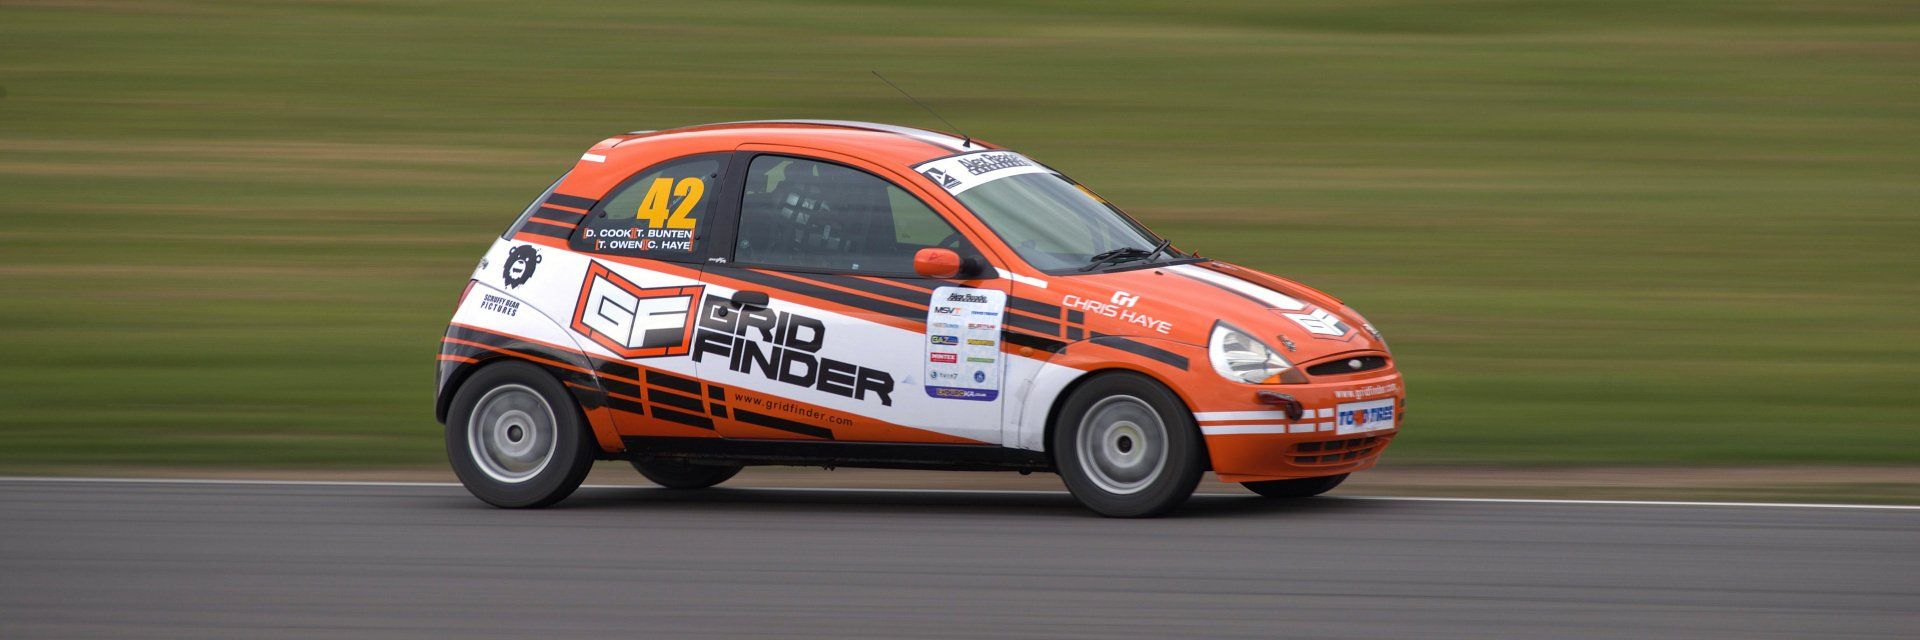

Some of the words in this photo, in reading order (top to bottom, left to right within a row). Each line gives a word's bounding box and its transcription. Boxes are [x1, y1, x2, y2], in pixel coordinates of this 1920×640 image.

[636, 177, 705, 229] 42
[585, 229, 597, 238] D.
[599, 229, 632, 238] COOK
[636, 229, 645, 238] T.
[647, 229, 693, 239] BUNTEN
[598, 240, 607, 249] T.
[609, 240, 643, 249] OWEN
[647, 240, 658, 250] C.
[661, 240, 691, 250] HAYE
[480, 301, 517, 317] PICTURES
[483, 294, 506, 305] SCRUFFY
[505, 299, 520, 309] BEAR
[1061, 294, 1120, 317] CHRIS
[1119, 310, 1173, 335] HAYE
[698, 294, 826, 354] GRID
[692, 328, 895, 407] FINDER
[734, 393, 854, 426] www.gridfinder.com
